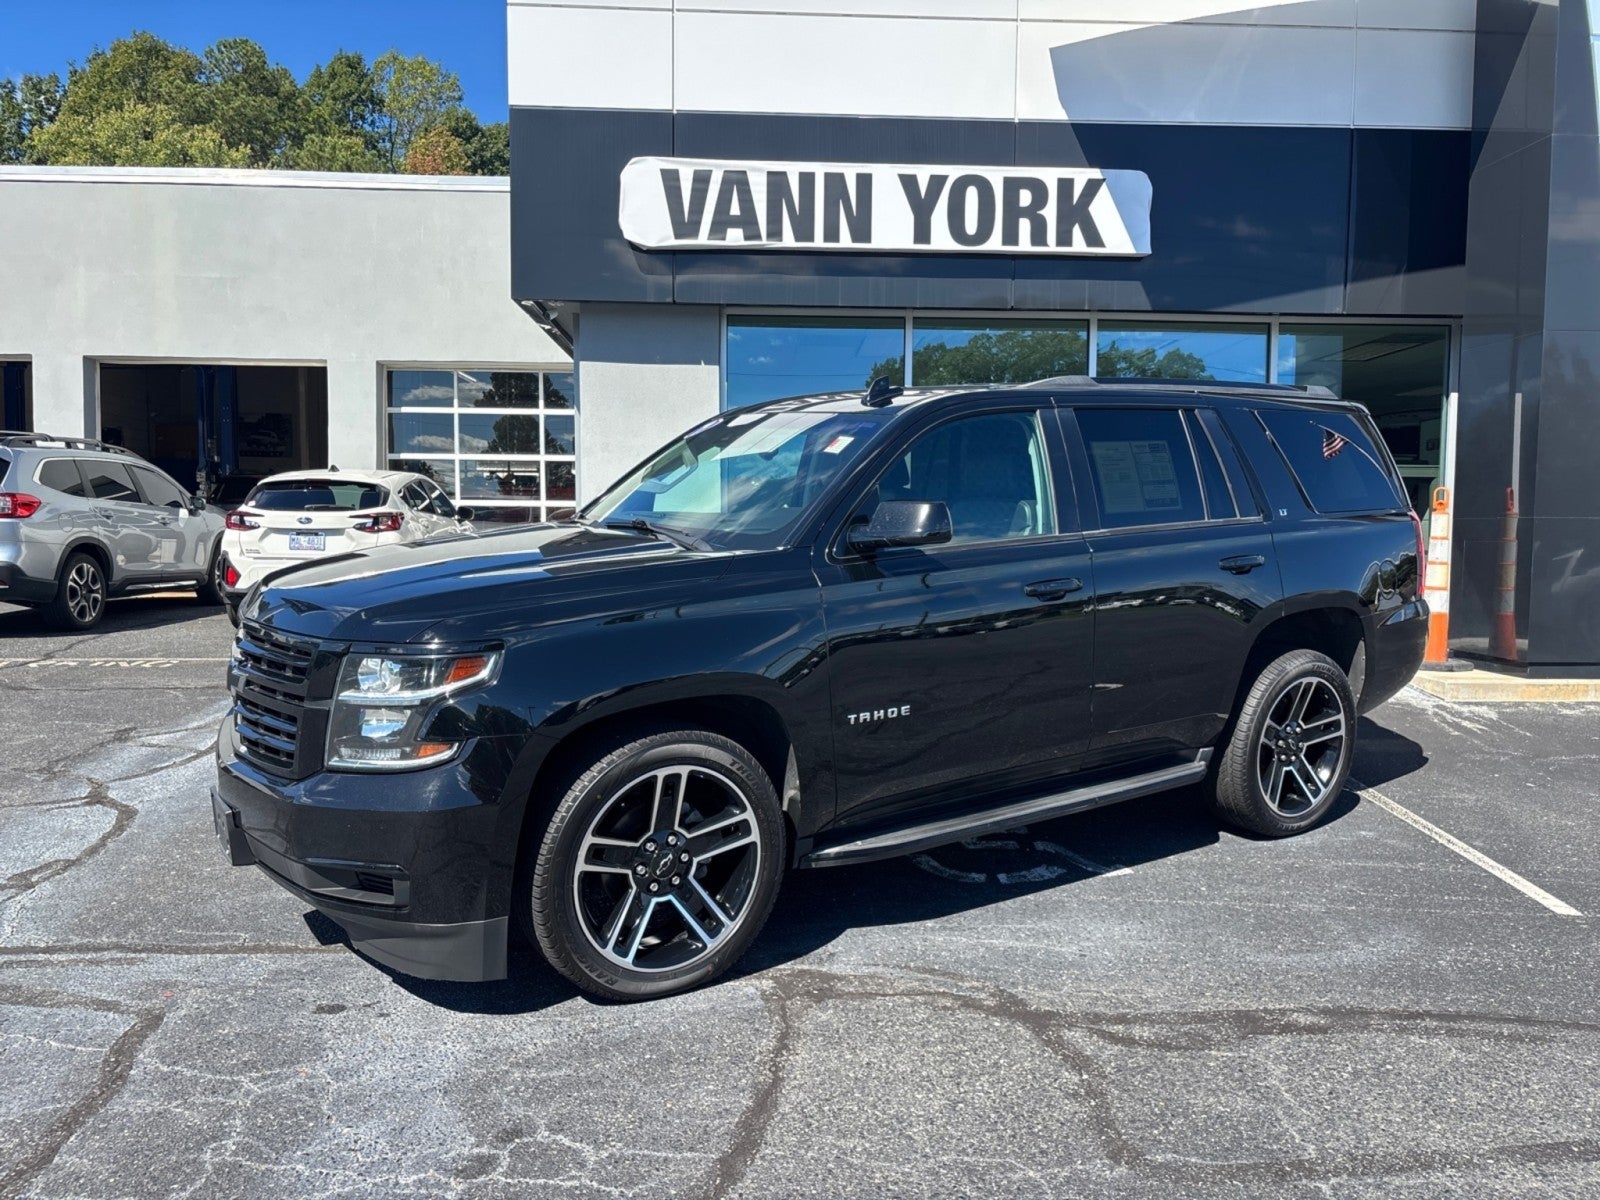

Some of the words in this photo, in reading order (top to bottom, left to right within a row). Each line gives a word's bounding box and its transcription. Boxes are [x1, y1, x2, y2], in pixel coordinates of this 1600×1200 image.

[660, 168, 873, 244] VANN
[897, 173, 1107, 249] YORK
[847, 705, 911, 725] TAHOE
